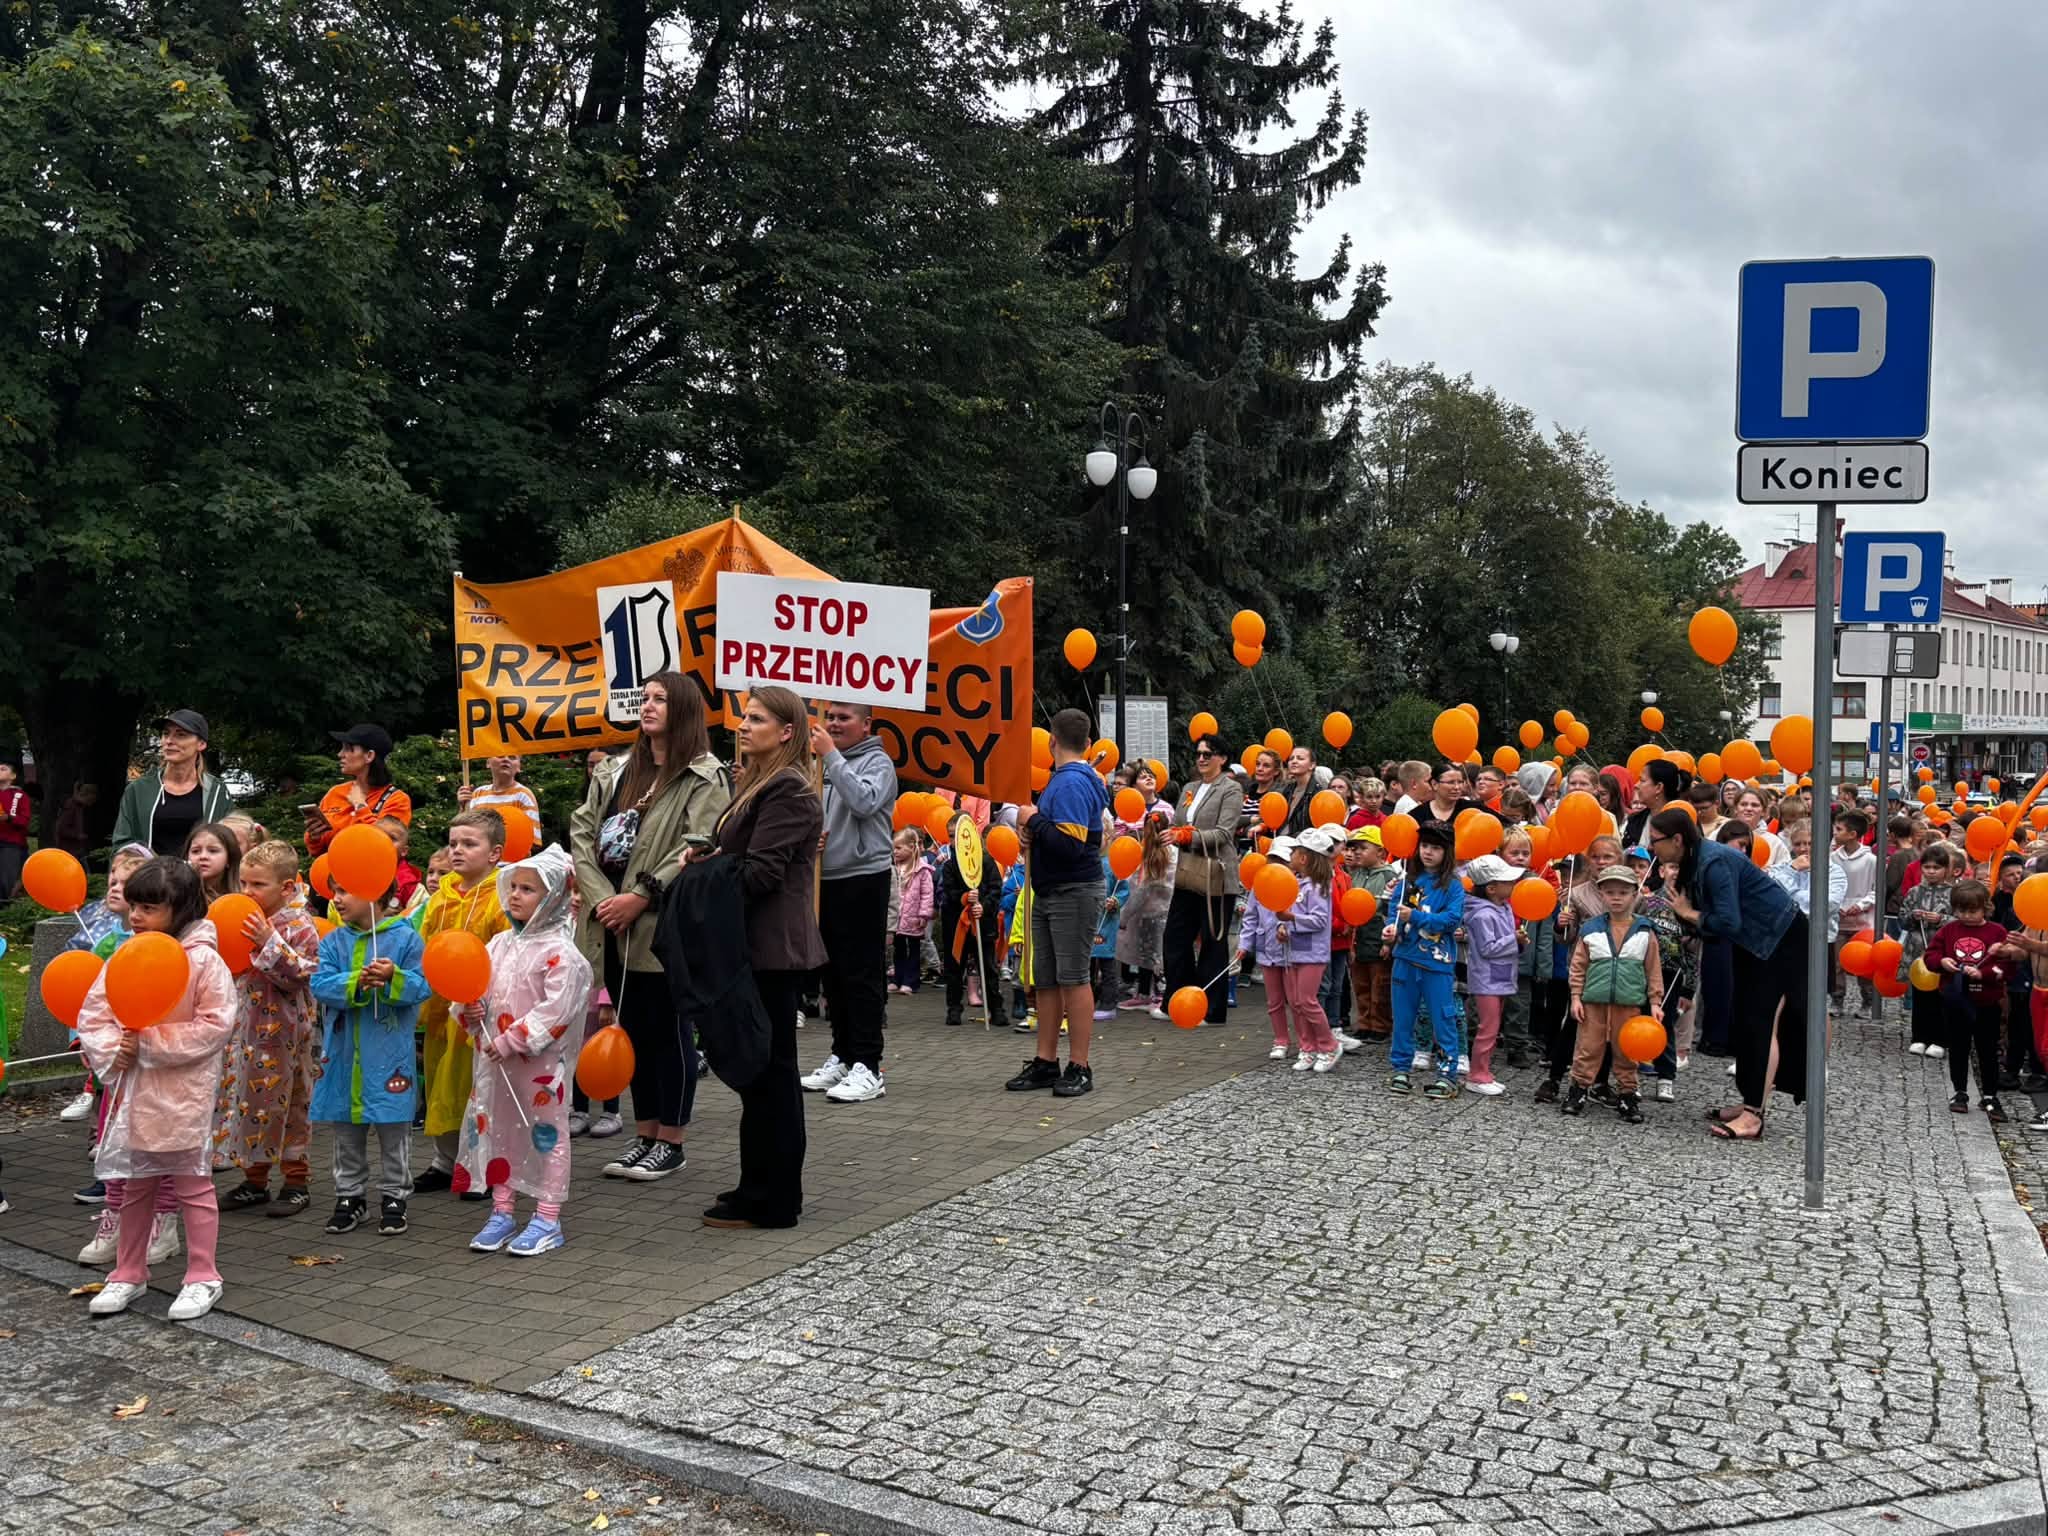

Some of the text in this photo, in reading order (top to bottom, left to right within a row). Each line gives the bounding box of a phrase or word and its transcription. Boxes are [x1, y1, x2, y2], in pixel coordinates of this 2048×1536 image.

[1781, 281, 1887, 417] P
[1762, 457, 1903, 489] Koniec
[1865, 543, 1922, 611] P
[774, 594, 868, 637] STOP
[722, 640, 922, 694] PRZEMOCY
